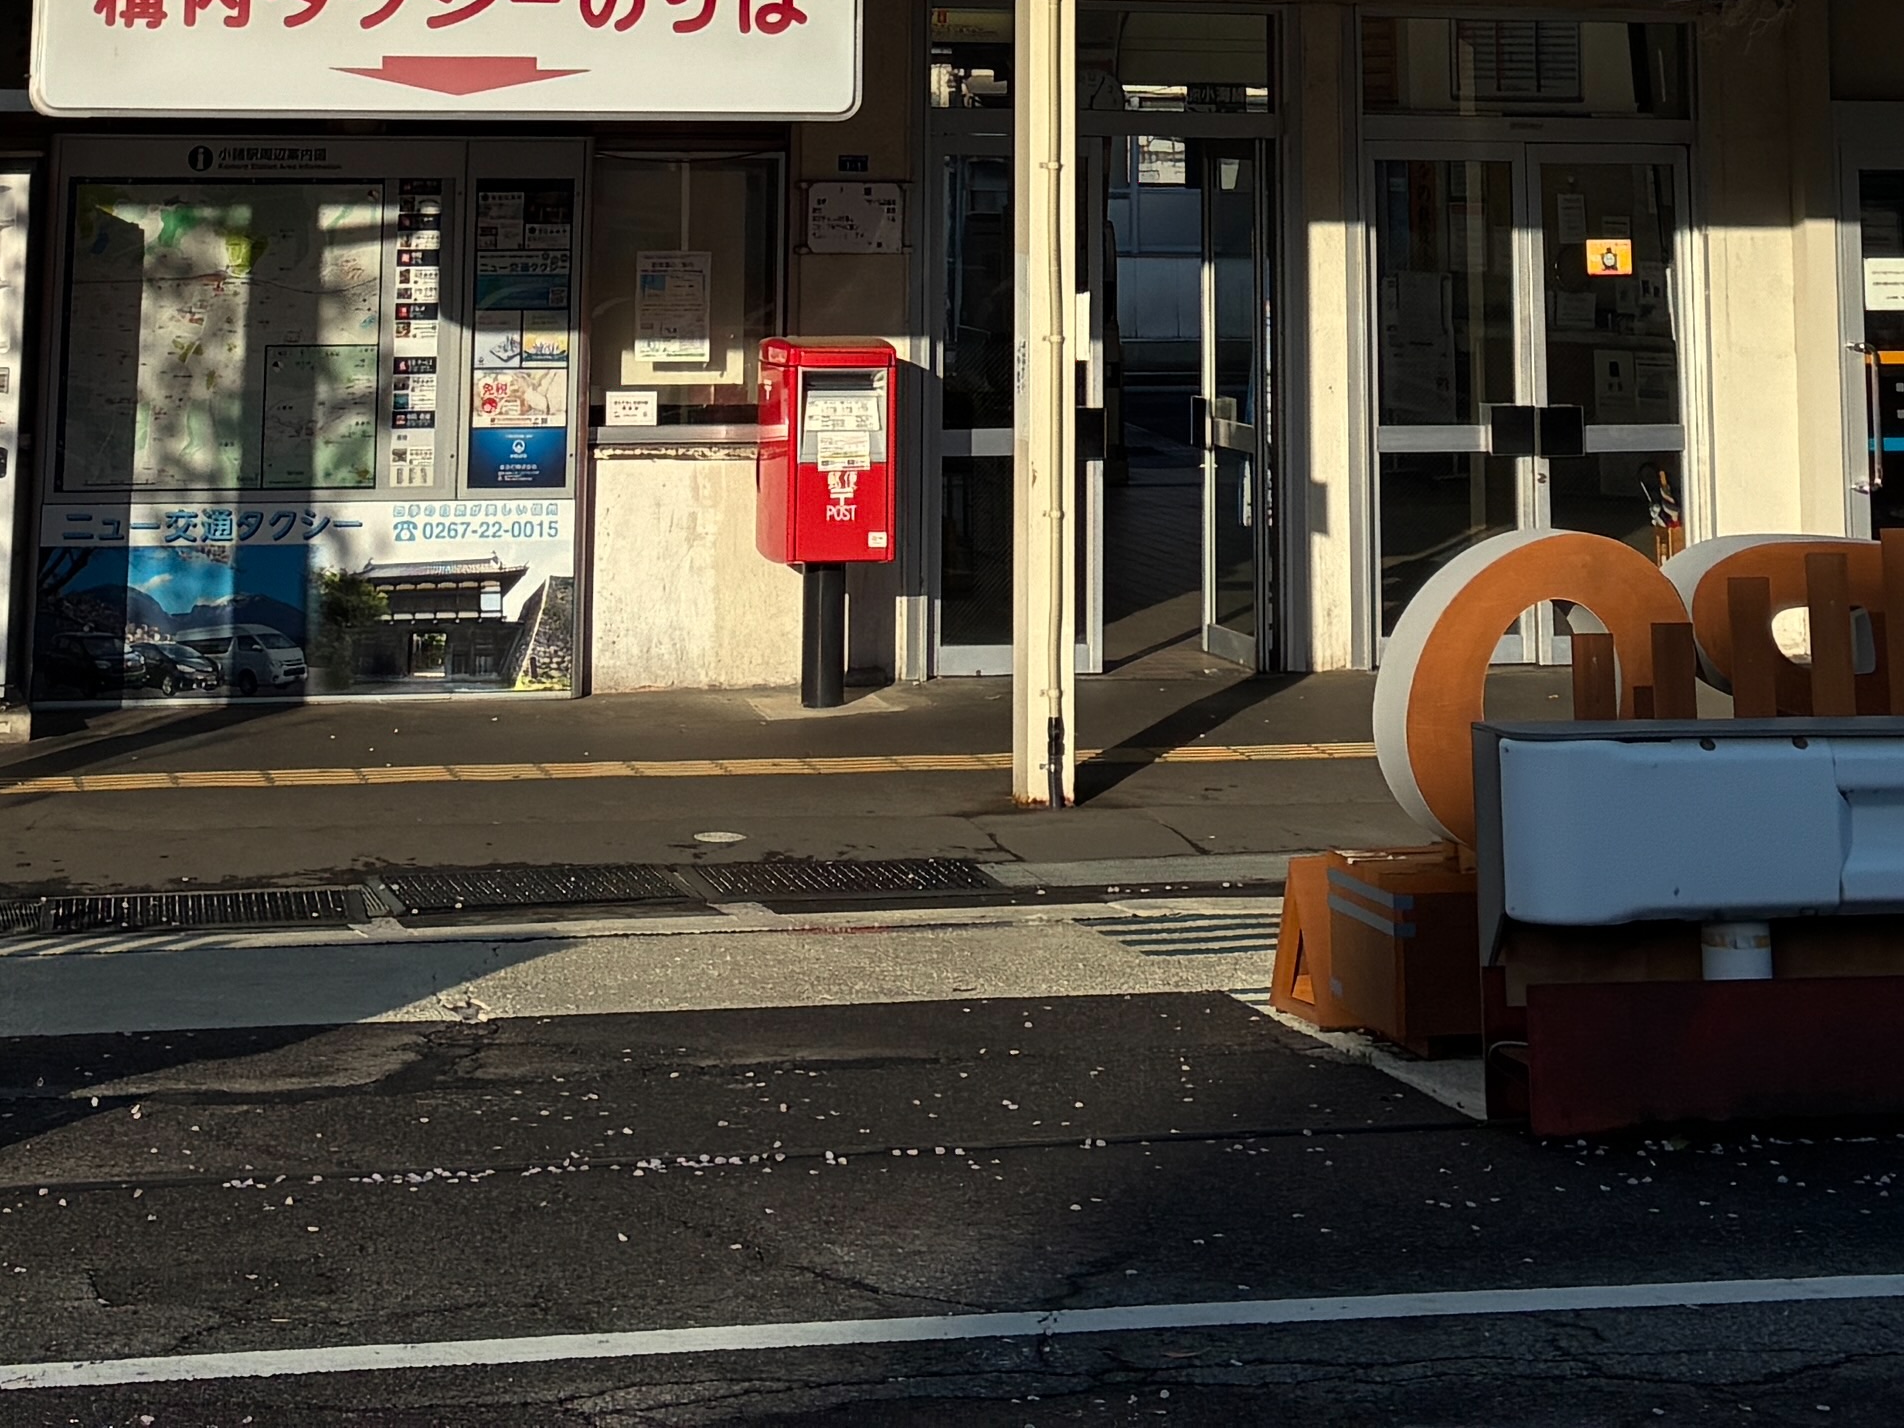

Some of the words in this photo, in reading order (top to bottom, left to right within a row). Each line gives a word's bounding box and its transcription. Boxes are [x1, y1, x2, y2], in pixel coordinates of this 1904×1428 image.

[825, 504, 858, 521] POST
[62, 508, 363, 543] ニュー交通タクシー
[422, 520, 559, 539] 0267-22-0015
